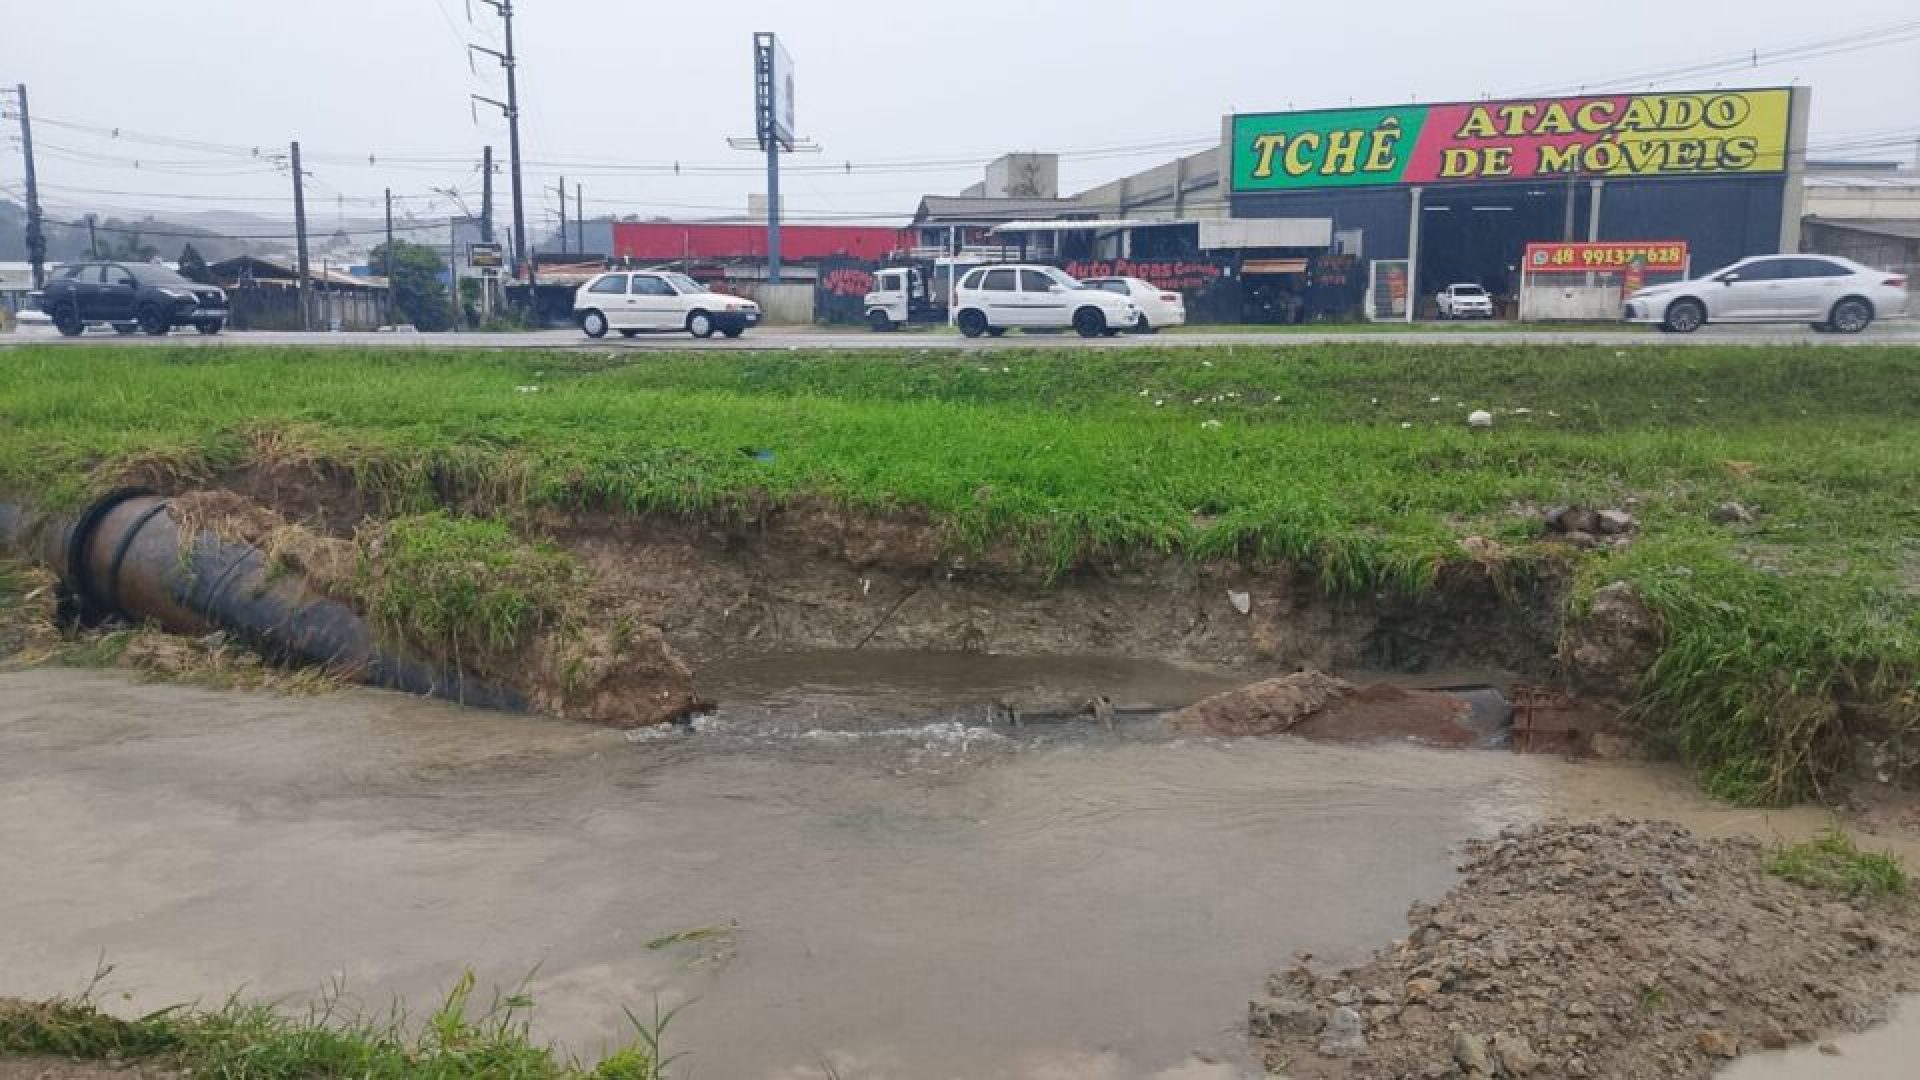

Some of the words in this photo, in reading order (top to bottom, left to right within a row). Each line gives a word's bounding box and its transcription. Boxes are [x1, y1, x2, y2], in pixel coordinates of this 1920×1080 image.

[1455, 94, 1750, 138] ATACADO
[1253, 116, 1401, 178] TCHÊ
[1440, 147, 1513, 178] DE
[1537, 135, 1758, 174] MÓVEIS
[1065, 258, 1111, 279] Auto
[1552, 248, 1574, 264] 48
